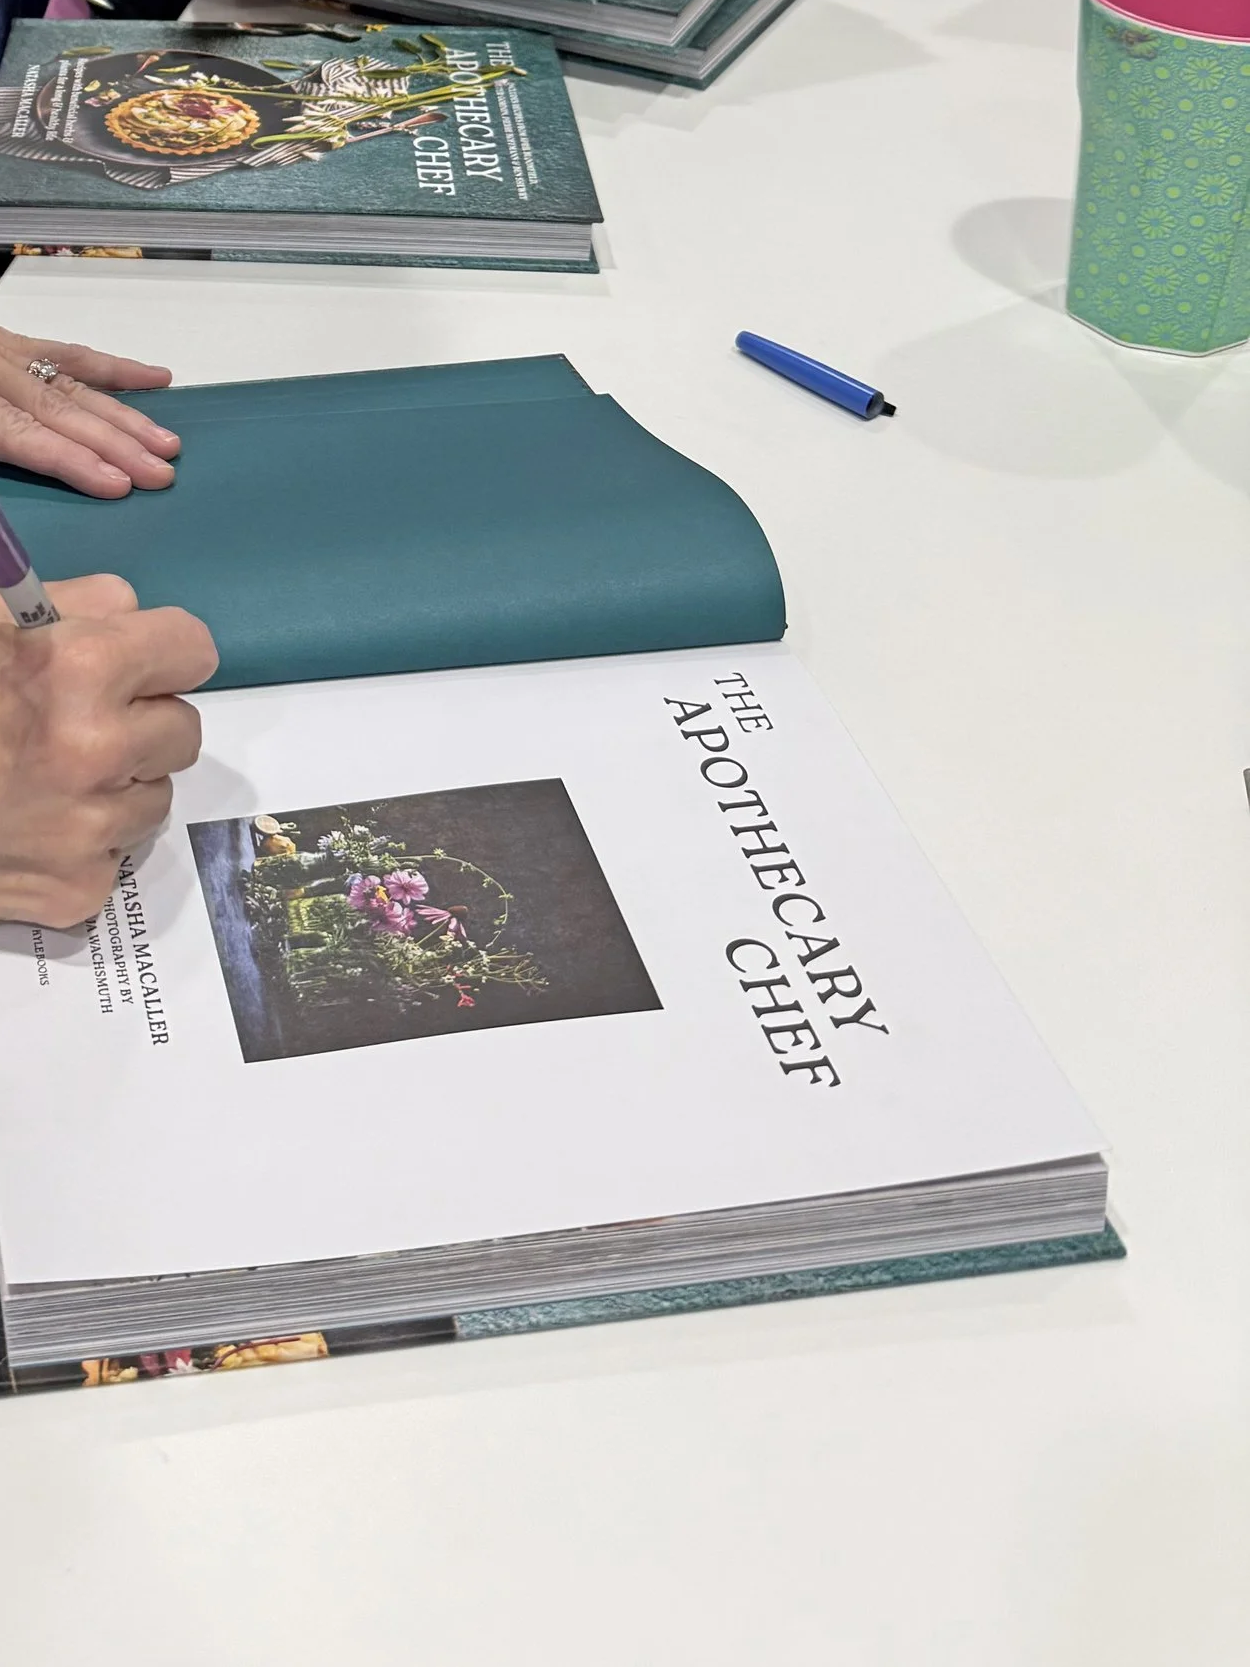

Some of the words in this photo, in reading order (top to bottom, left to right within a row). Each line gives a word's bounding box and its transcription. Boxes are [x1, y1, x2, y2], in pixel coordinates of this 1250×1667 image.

[20, 64, 41, 97] NATASHA
[486, 42, 515, 67] THE
[11, 97, 34, 138] MACALLER
[445, 47, 503, 182] APOTHECARY
[413, 136, 456, 196] CHEF
[713, 672, 774, 733] THE
[663, 696, 890, 1035] APOTHECARY
[35, 953, 50, 986] BOOKS
[88, 934, 113, 1014] WACHSMUTH
[119, 988, 133, 1004] BY
[132, 942, 170, 1045] MACALLER
[725, 938, 841, 1088] CHEF
